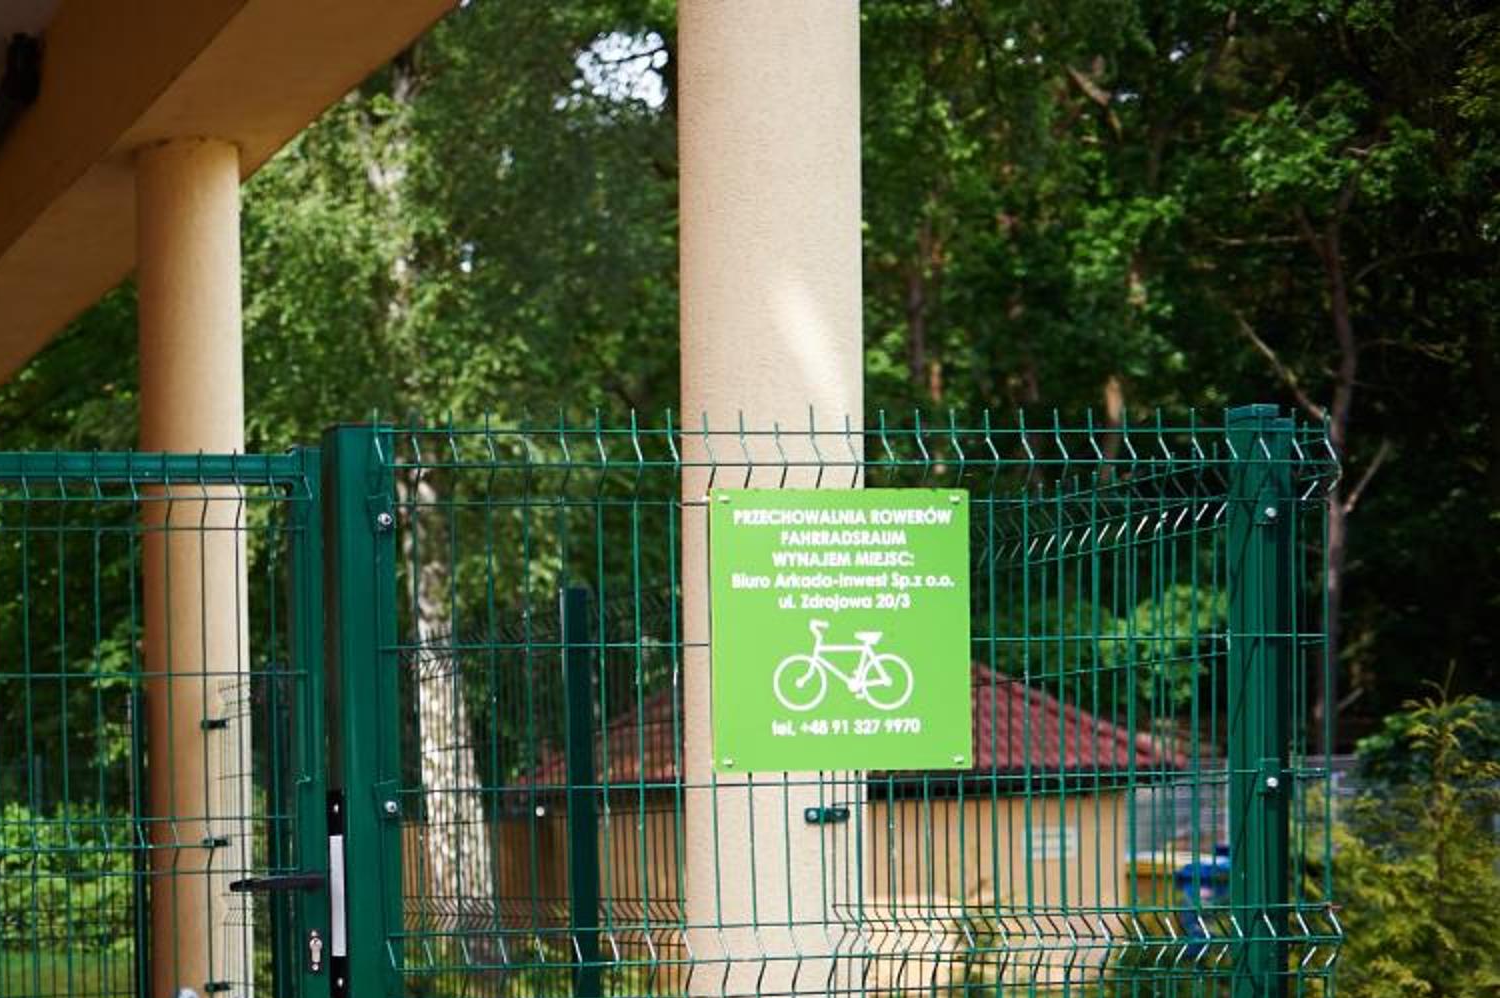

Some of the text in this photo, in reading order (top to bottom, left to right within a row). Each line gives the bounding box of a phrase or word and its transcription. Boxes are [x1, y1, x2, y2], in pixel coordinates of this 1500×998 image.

[732, 506, 953, 526] PRZECHOWALNIA ROWERÓW
[780, 530, 907, 546] FAHRRADSRAUM
[771, 550, 915, 568] WYNAJEM MIEJSC:
[731, 573, 771, 589] Biuro
[778, 592, 911, 613] ul. Zdrojowa 20/3
[771, 717, 922, 737] tel. +48 91 327 9970
